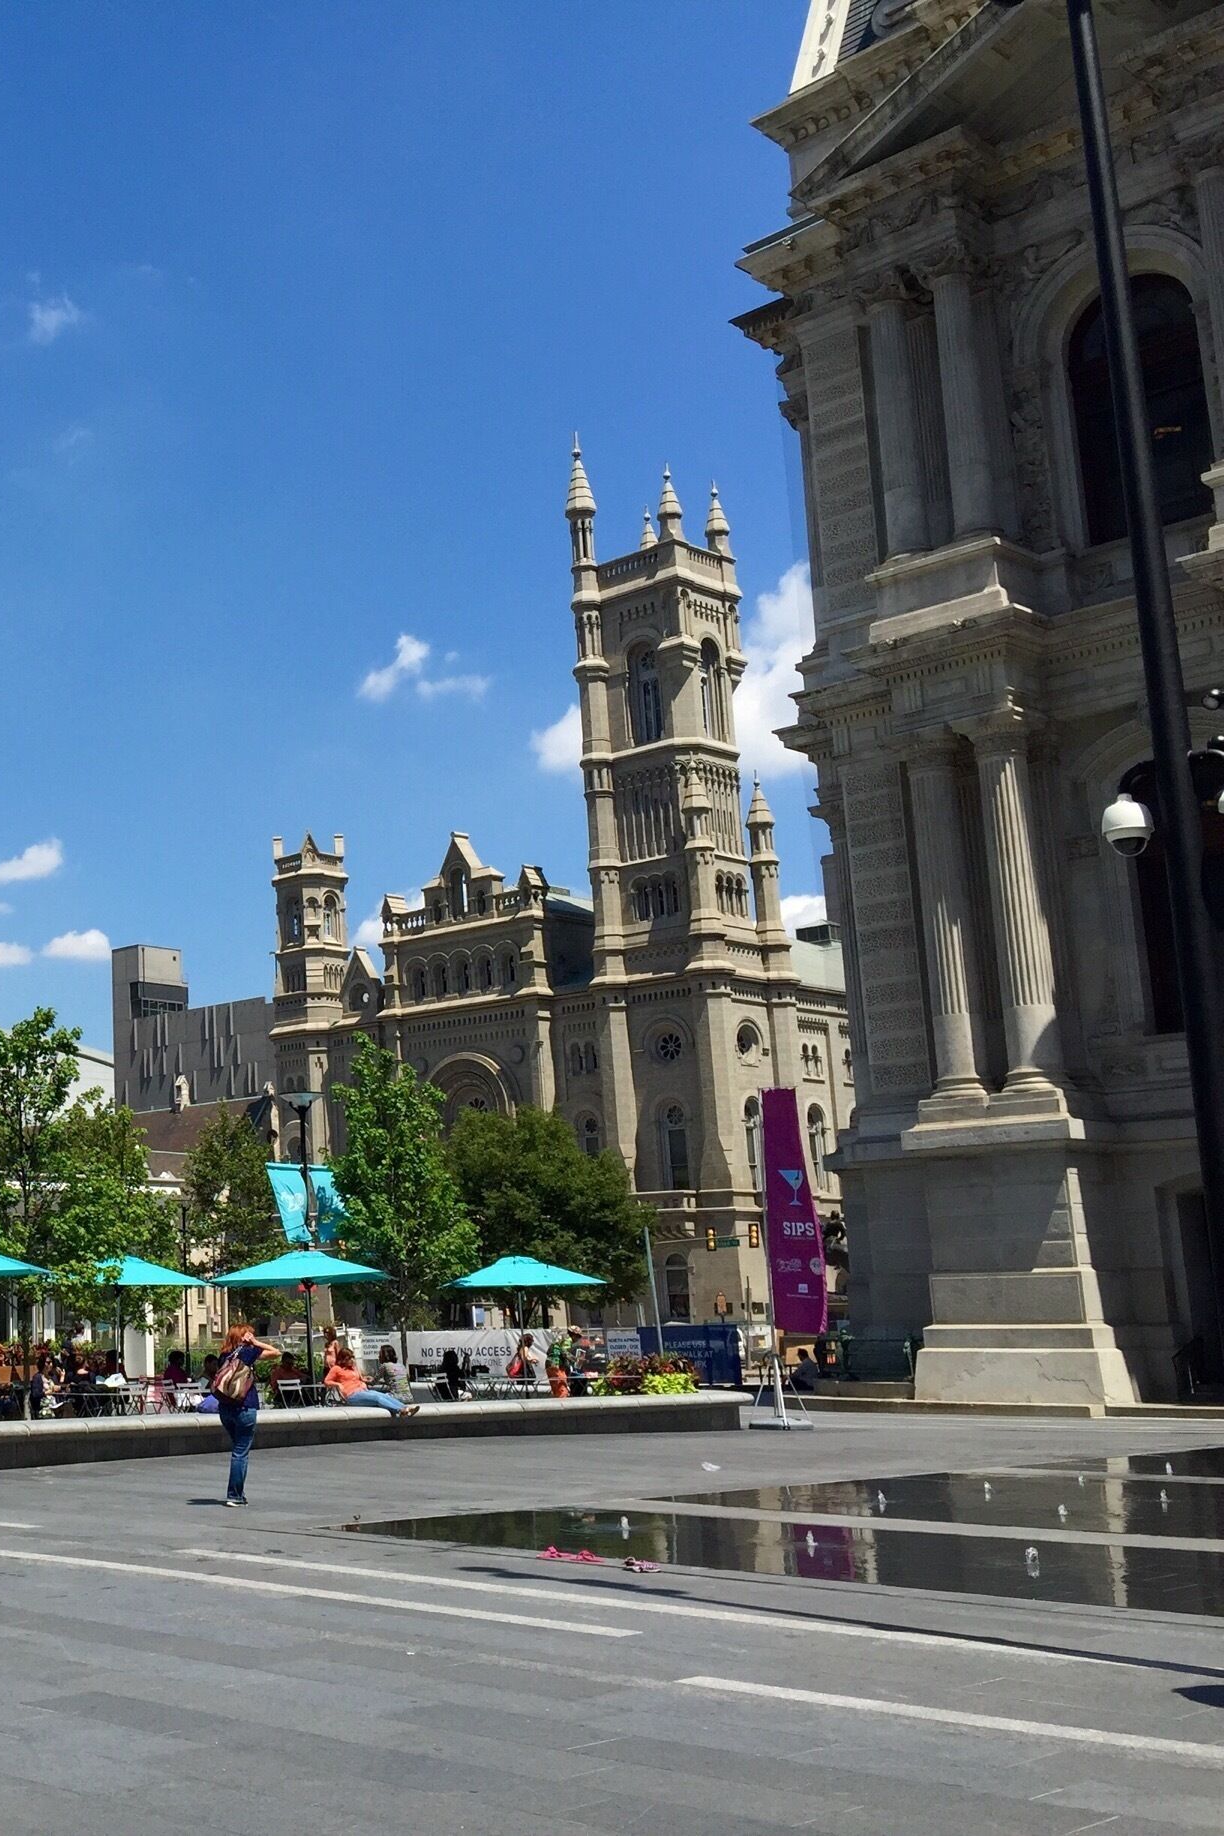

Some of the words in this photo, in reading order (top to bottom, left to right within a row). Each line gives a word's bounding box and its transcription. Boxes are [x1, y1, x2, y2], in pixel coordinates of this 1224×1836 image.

[783, 1222, 815, 1236] SIPS
[421, 1348, 433, 1357] NO
[436, 1347, 472, 1357] EX/NO
[476, 1346, 511, 1356] ACCESS
